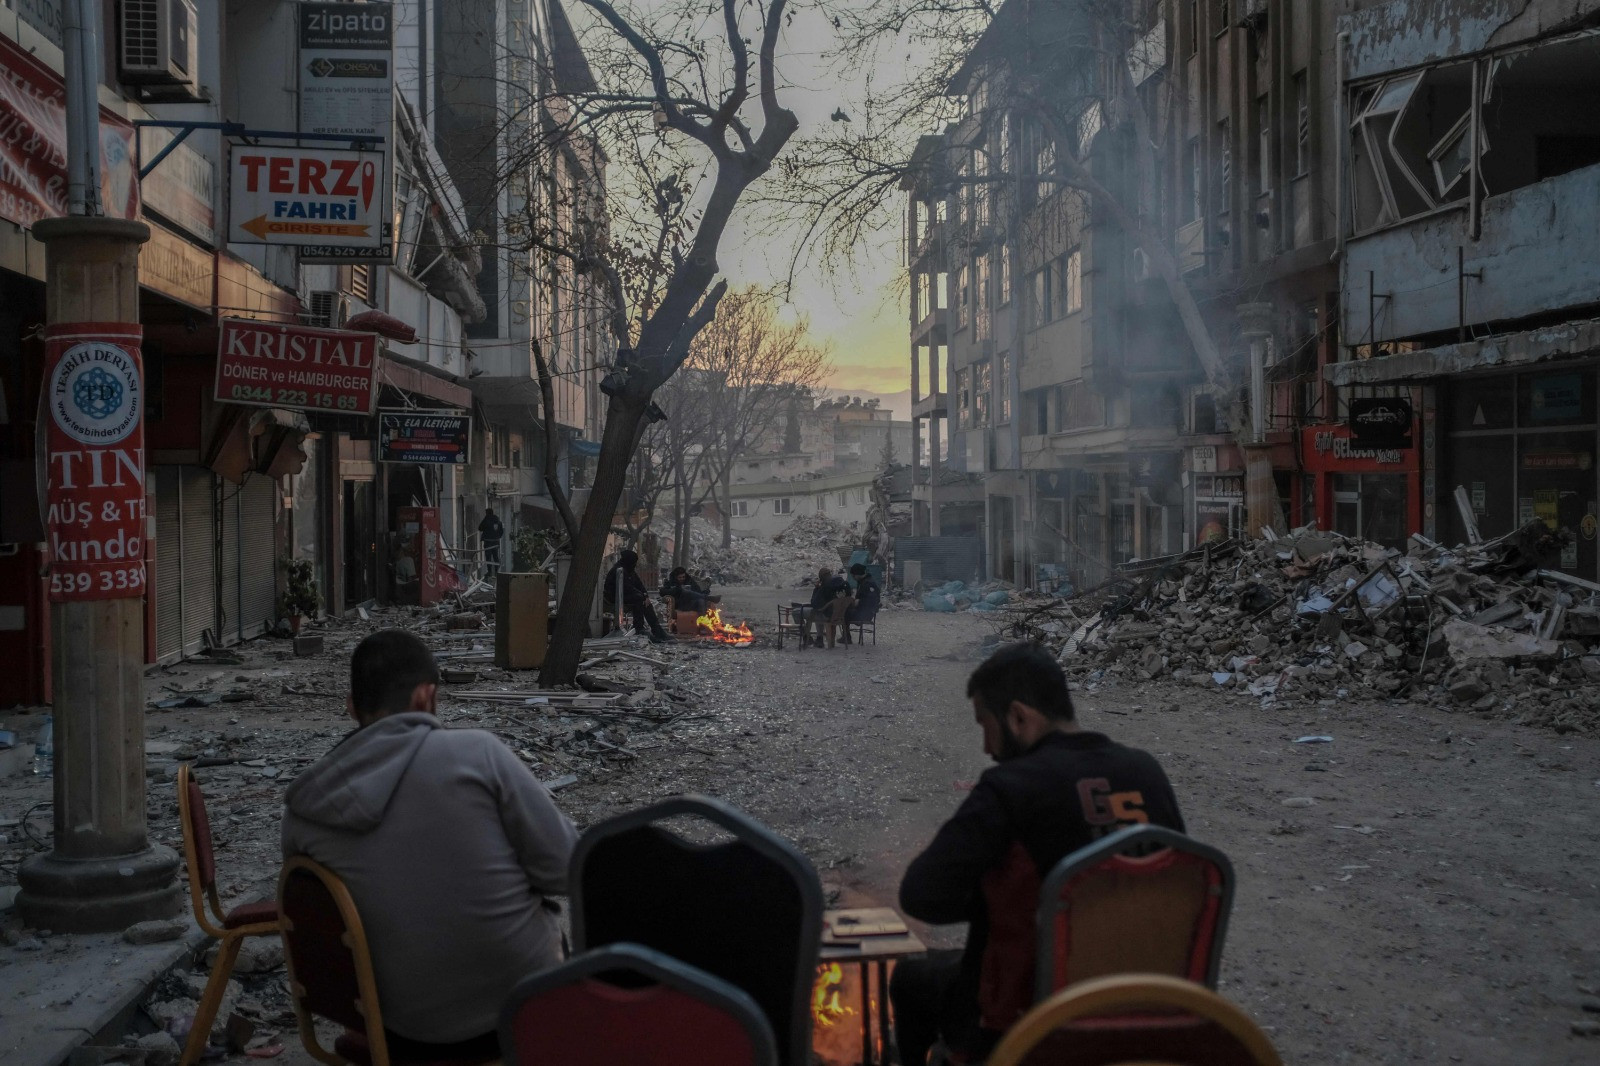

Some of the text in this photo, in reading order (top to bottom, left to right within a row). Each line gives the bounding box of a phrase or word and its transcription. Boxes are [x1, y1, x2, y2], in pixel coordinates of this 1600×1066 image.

[307, 9, 386, 34] zipato
[274, 199, 357, 221] FAHRİ
[226, 327, 372, 369] KRİSTAL
[55, 349, 138, 396] TESBİH DERYASI
[223, 362, 369, 391] DÖNER ve HAMBURGER
[231, 384, 273, 401] 0344
[276, 388, 308, 405] 223
[311, 392, 333, 408] 15
[404, 416, 461, 431] ELA İLETİŞİM
[48, 448, 145, 490] TIN
[101, 500, 121, 522] &
